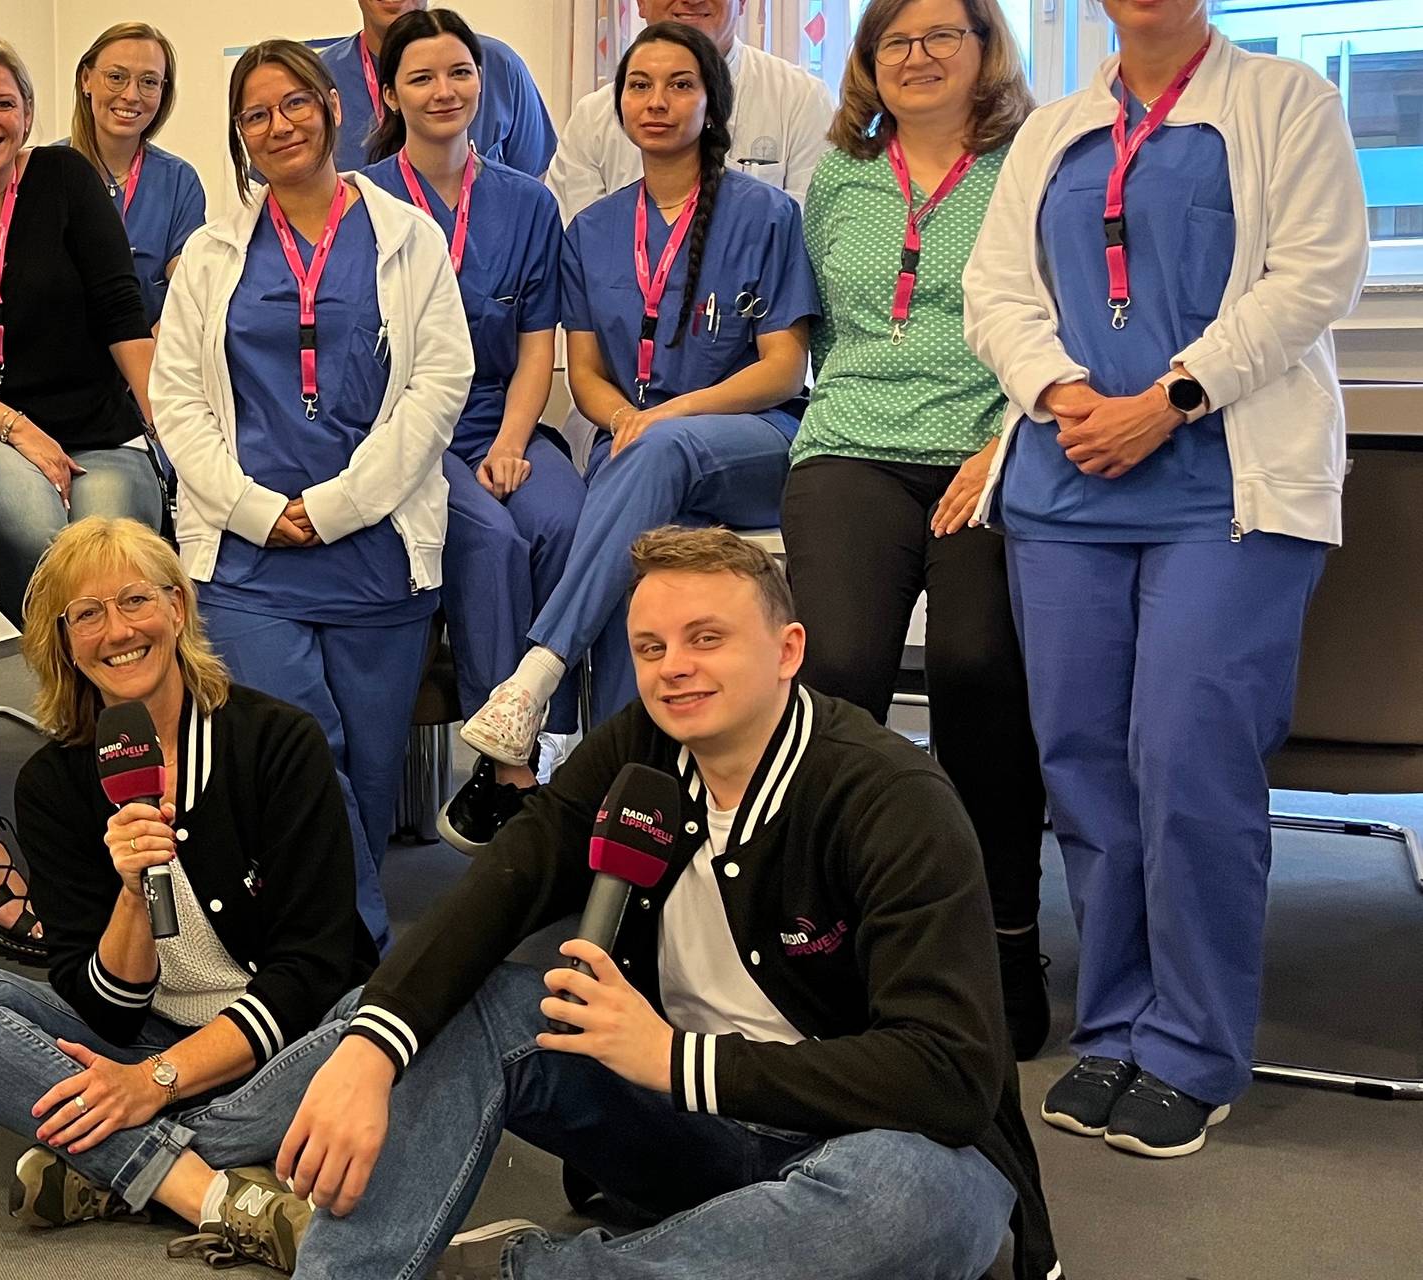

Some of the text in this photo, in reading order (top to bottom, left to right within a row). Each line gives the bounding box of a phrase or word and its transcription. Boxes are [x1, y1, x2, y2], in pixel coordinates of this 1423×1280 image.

[99, 742, 123, 756] RADIO
[621, 807, 654, 825] RADIO
[619, 815, 674, 844] LIPPEWELLE
[234, 1183, 276, 1217] N
